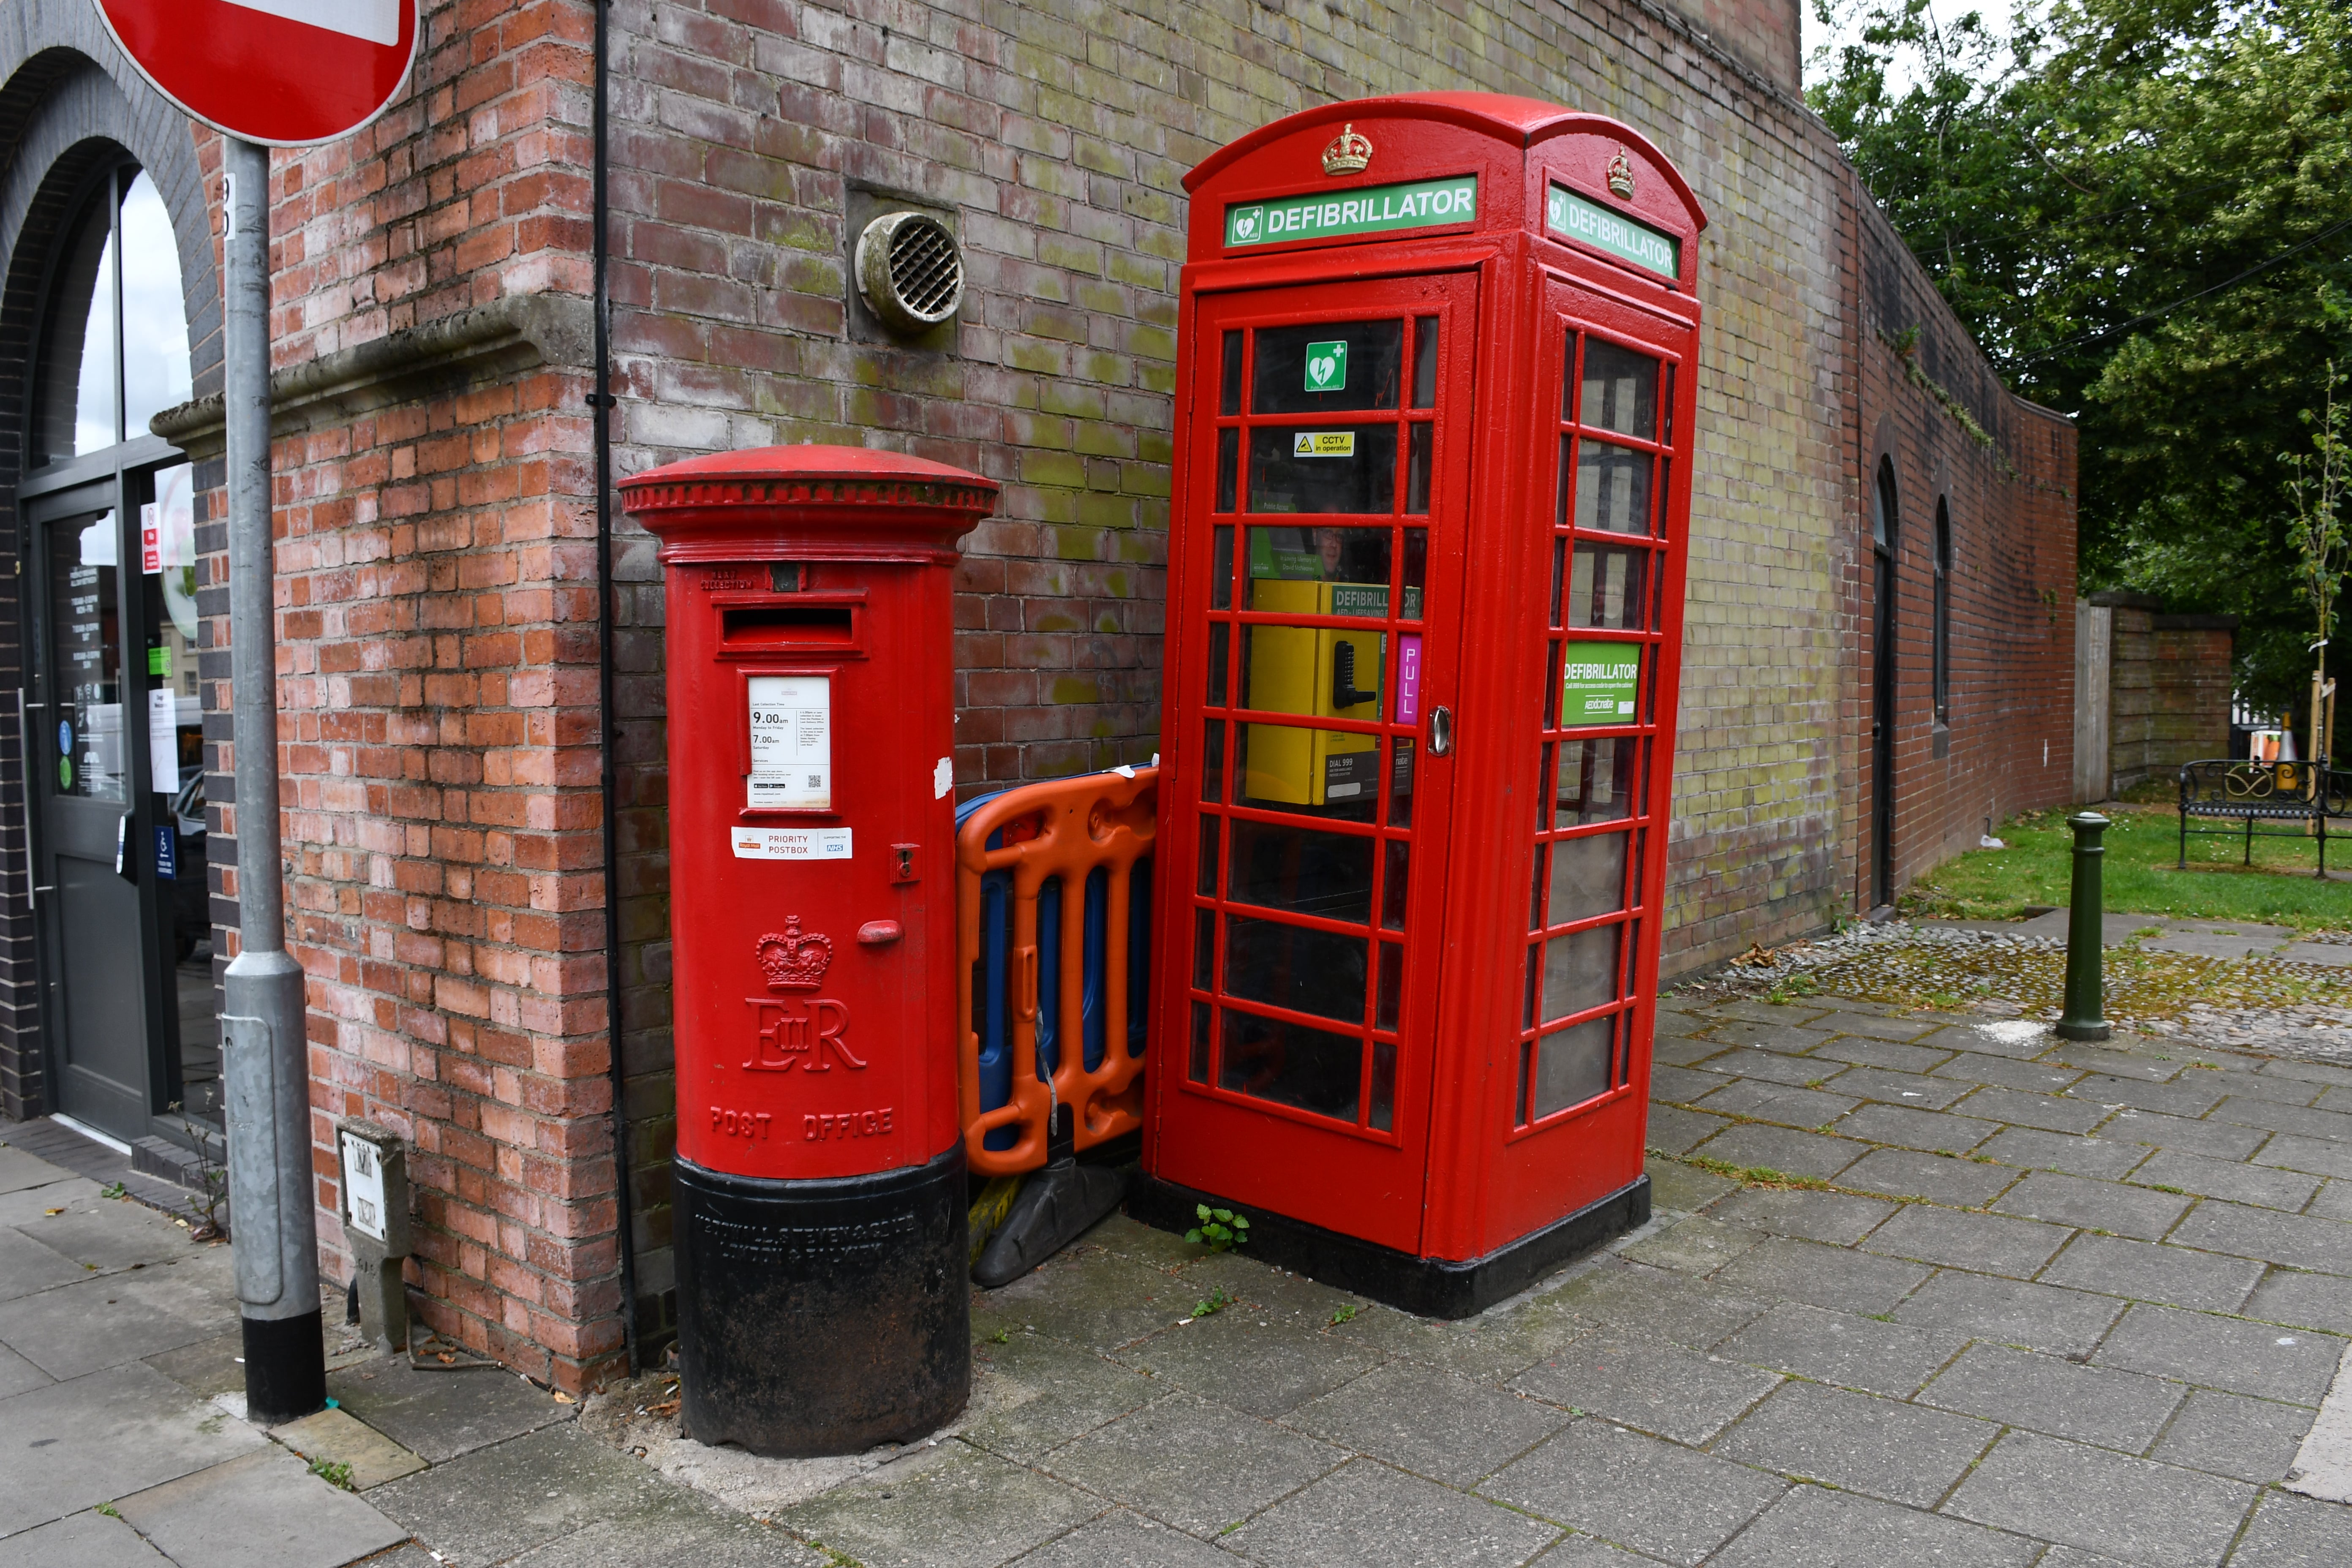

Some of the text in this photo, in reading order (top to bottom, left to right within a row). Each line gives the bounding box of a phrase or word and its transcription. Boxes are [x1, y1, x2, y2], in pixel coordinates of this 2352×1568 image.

[1268, 188, 1473, 233] DEFIBRILLATOR
[1569, 203, 1673, 270] DEFIBRILLATOR
[1322, 436, 1345, 444] CCTV
[1323, 445, 1351, 453] operation
[700, 580, 752, 590] COLLECTION
[1564, 663, 1637, 680] DEFIBRILLATOR
[1404, 648, 1415, 714] PULL
[753, 711, 788, 724] 9.00am
[753, 735, 780, 743] 7.00am
[1342, 758, 1353, 766] 999
[768, 835, 808, 843] PRIORITY
[710, 1106, 893, 1141] POST OFFICE
